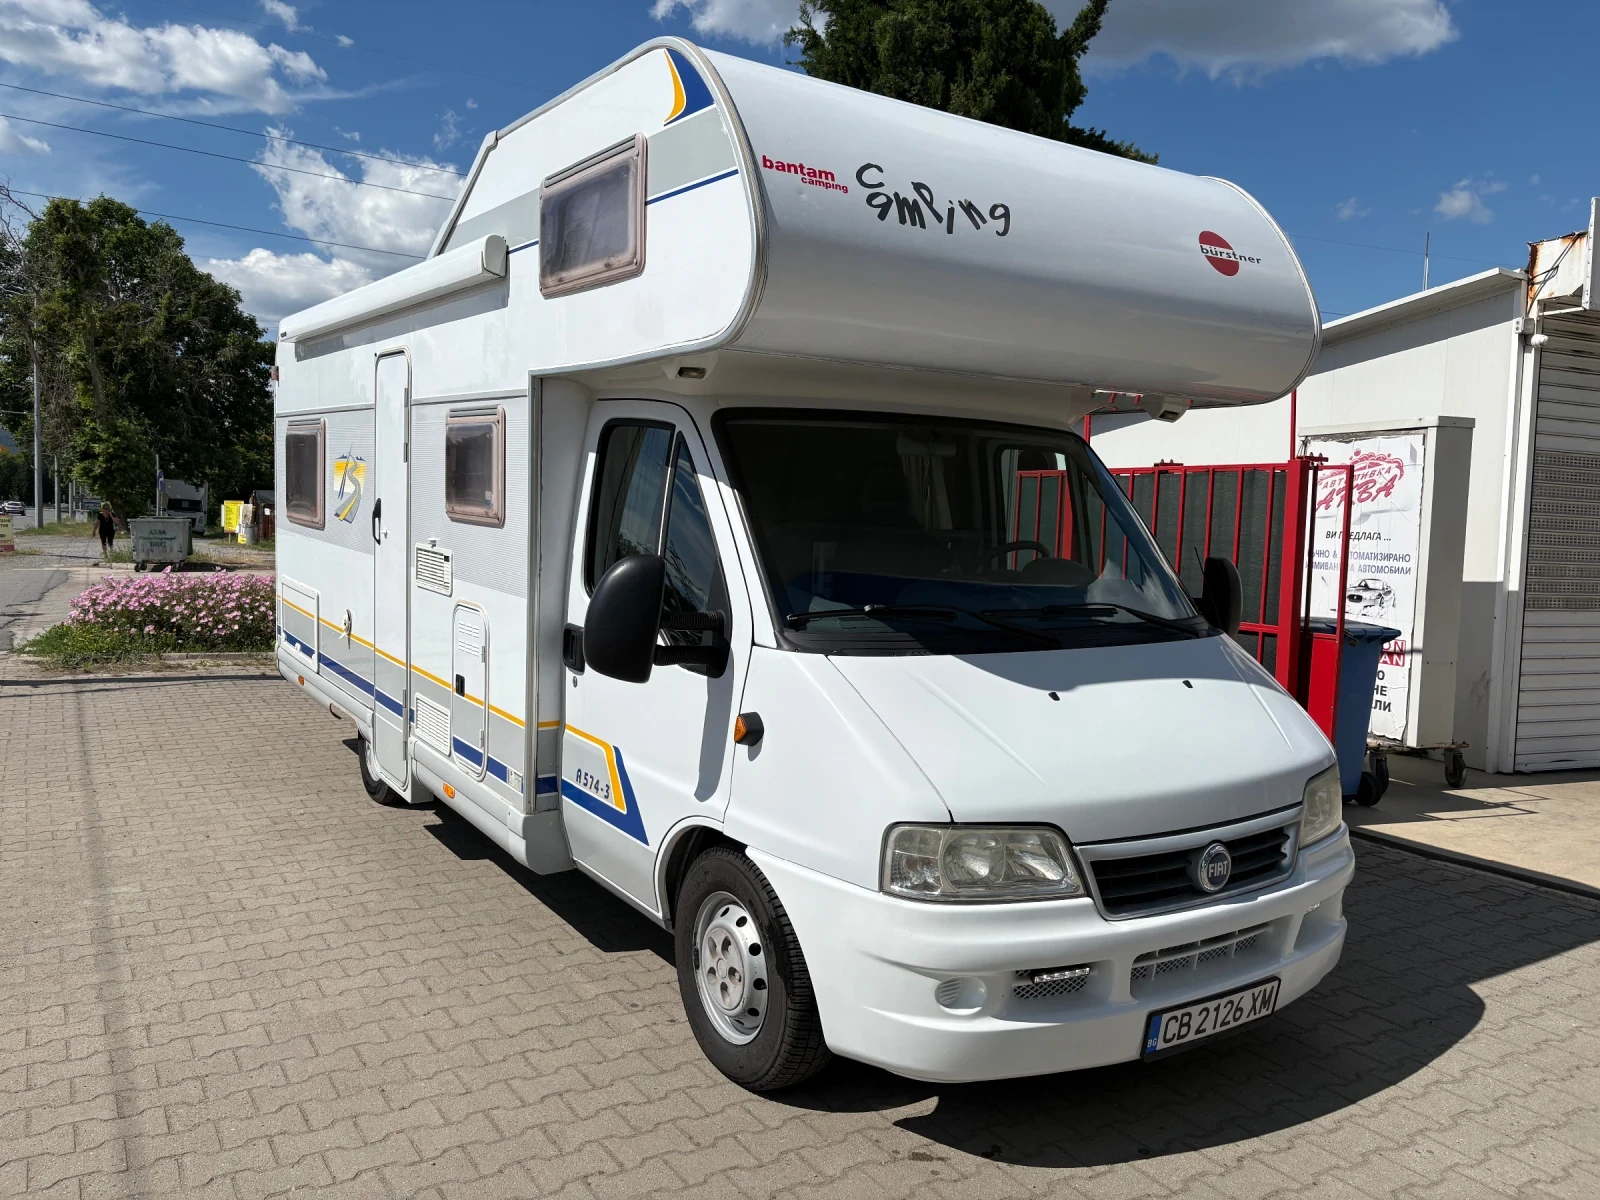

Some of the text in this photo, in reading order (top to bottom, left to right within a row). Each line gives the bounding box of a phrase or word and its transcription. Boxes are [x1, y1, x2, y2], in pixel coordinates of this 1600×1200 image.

[762, 155, 835, 182] bantam
[801, 176, 848, 194] camping
[1200, 244, 1262, 264] bürstner
[1322, 466, 1392, 490] АВТМИВКА
[1325, 530, 1337, 539] ВИ
[1349, 551, 1411, 563] ТОМАТИЗИРАНО
[1357, 564, 1411, 575] АВТОМОБИЛИ
[583, 771, 610, 800] 574-3
[1208, 860, 1228, 878] FIAT
[1162, 985, 1275, 1044] CB 2126 XM
[1147, 1037, 1158, 1048] BG
